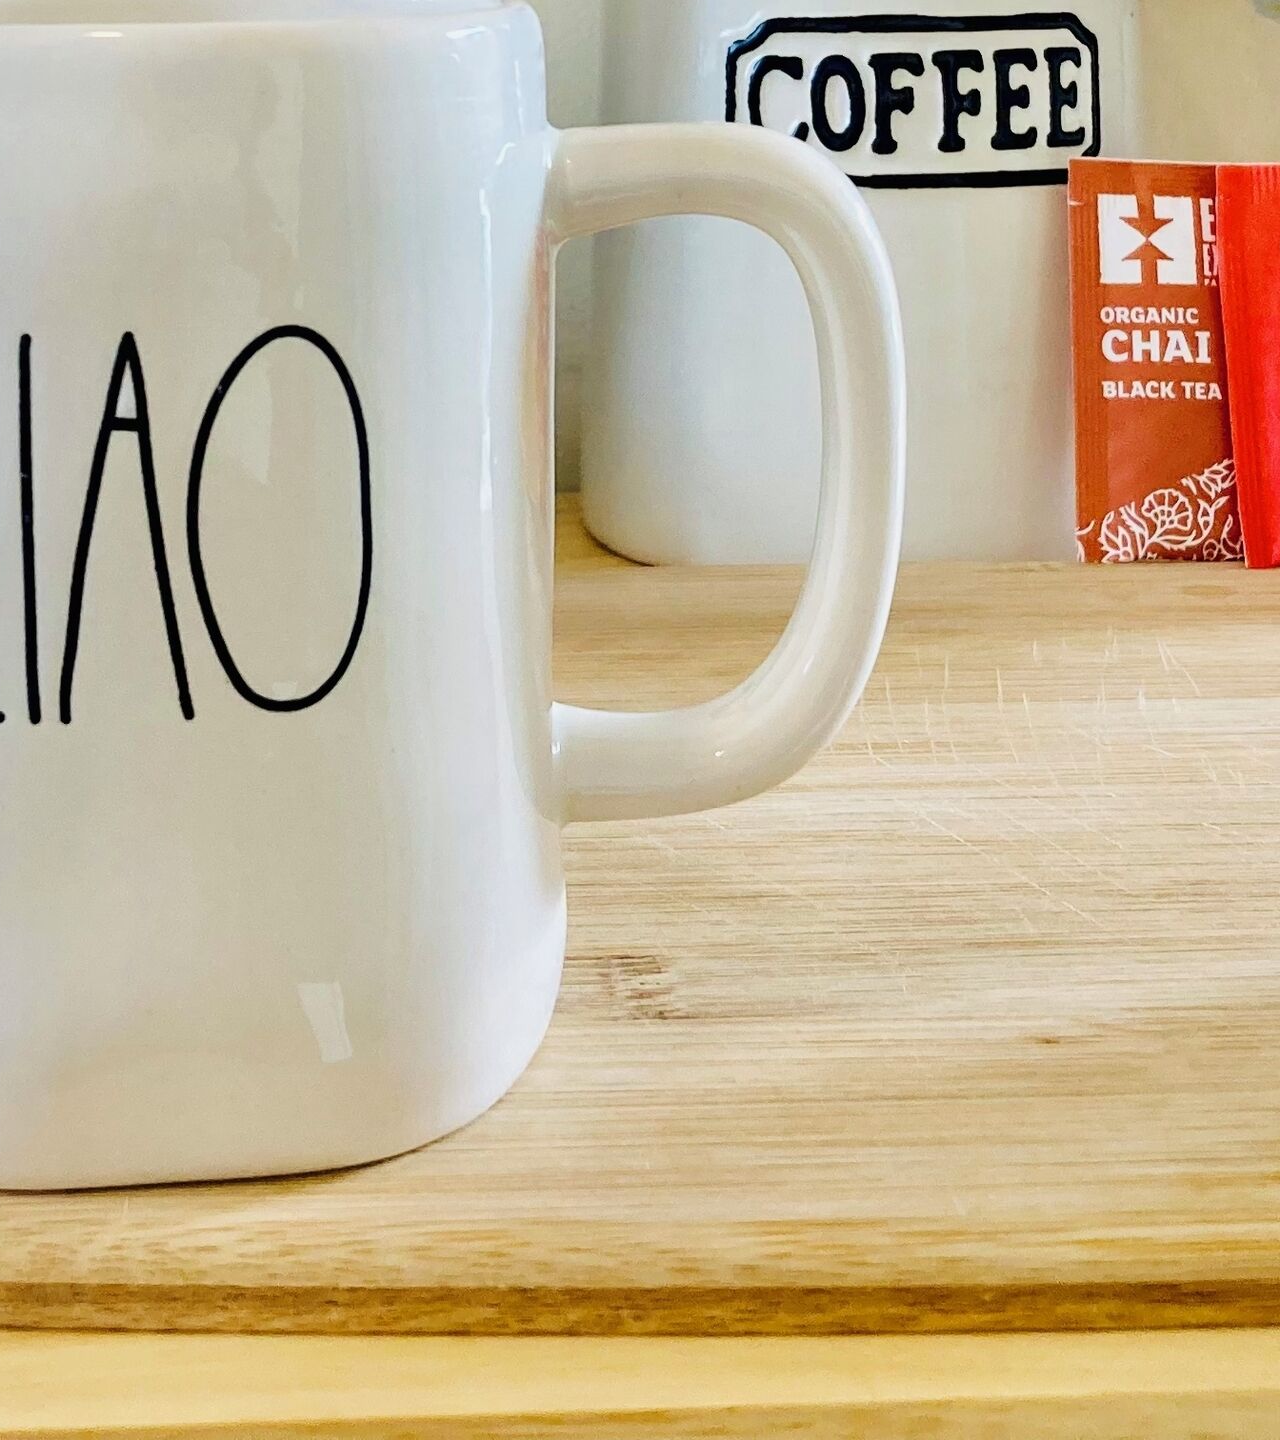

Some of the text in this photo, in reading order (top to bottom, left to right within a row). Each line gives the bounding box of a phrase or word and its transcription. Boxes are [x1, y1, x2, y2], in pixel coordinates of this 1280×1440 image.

[748, 47, 1085, 154] COFFEE
[1100, 307, 1199, 325] ORGANIC
[1101, 329, 1211, 364] CHAI
[1101, 380, 1222, 400] BLACK TEA
